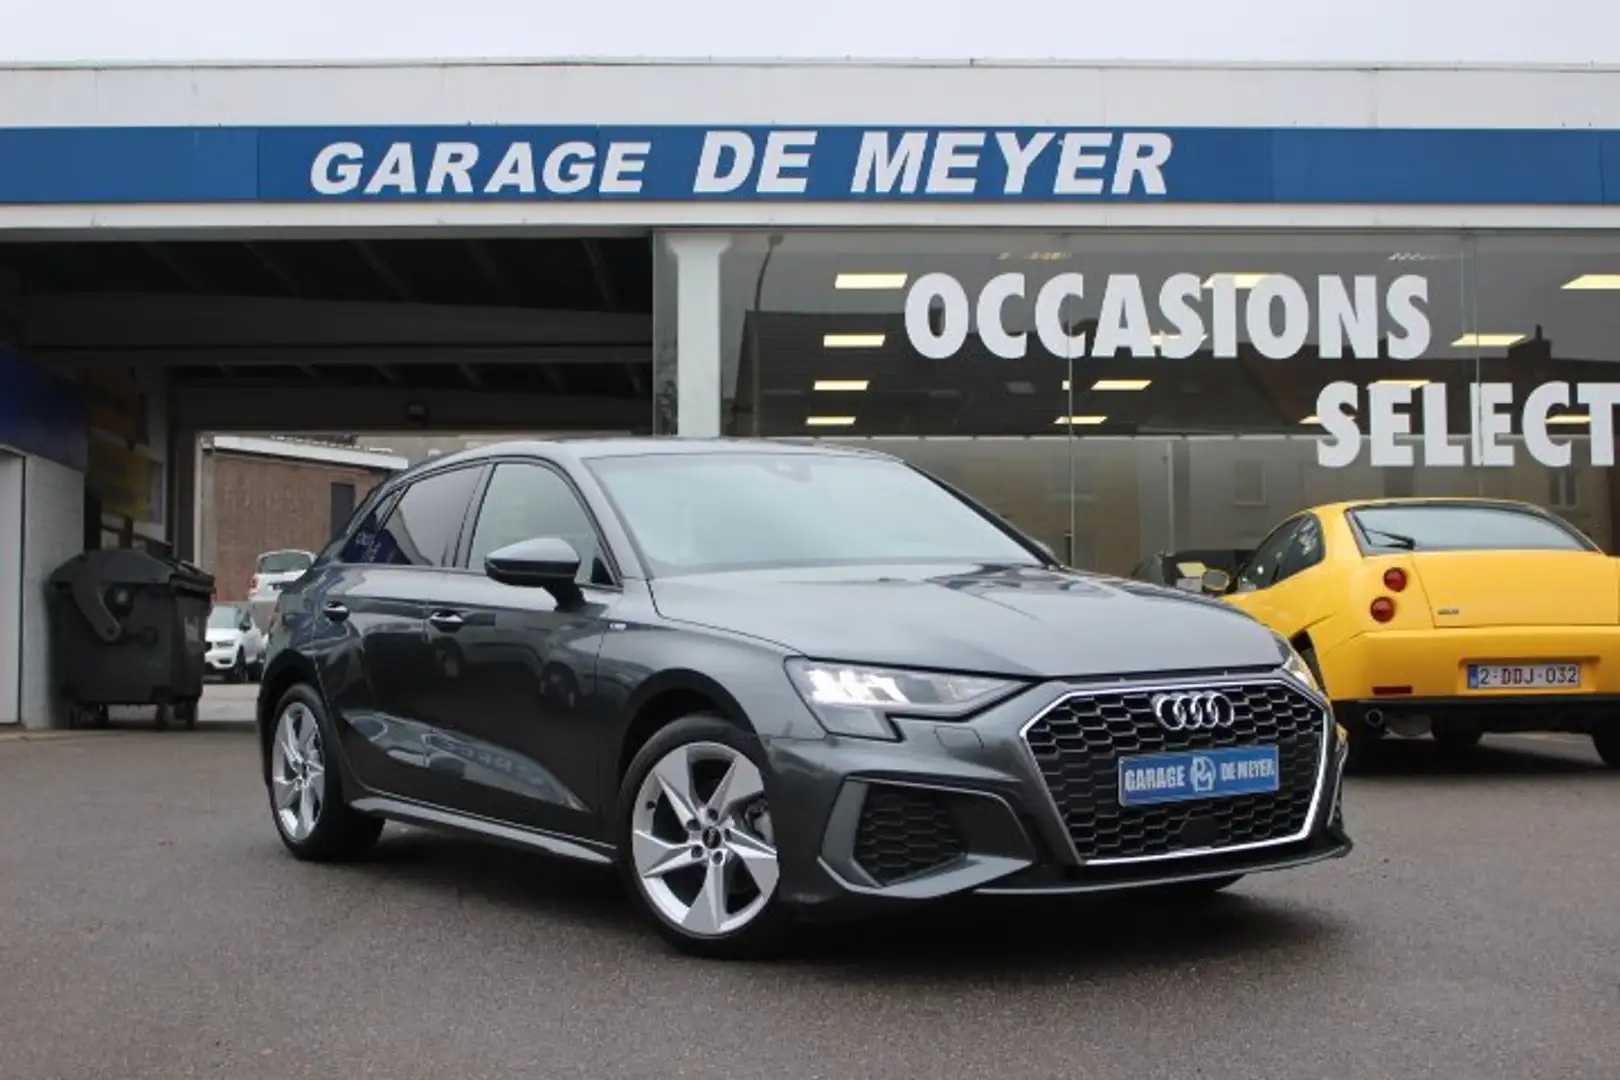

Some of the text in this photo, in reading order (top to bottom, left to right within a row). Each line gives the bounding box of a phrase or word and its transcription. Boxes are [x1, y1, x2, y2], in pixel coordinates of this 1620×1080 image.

[310, 130, 1173, 195] GARAGE DE MEYER
[904, 272, 1433, 360] OCCASIONS
[1315, 380, 1620, 468] SELECT
[1124, 765, 1185, 792] GARAGE
[1220, 762, 1237, 781] DE
